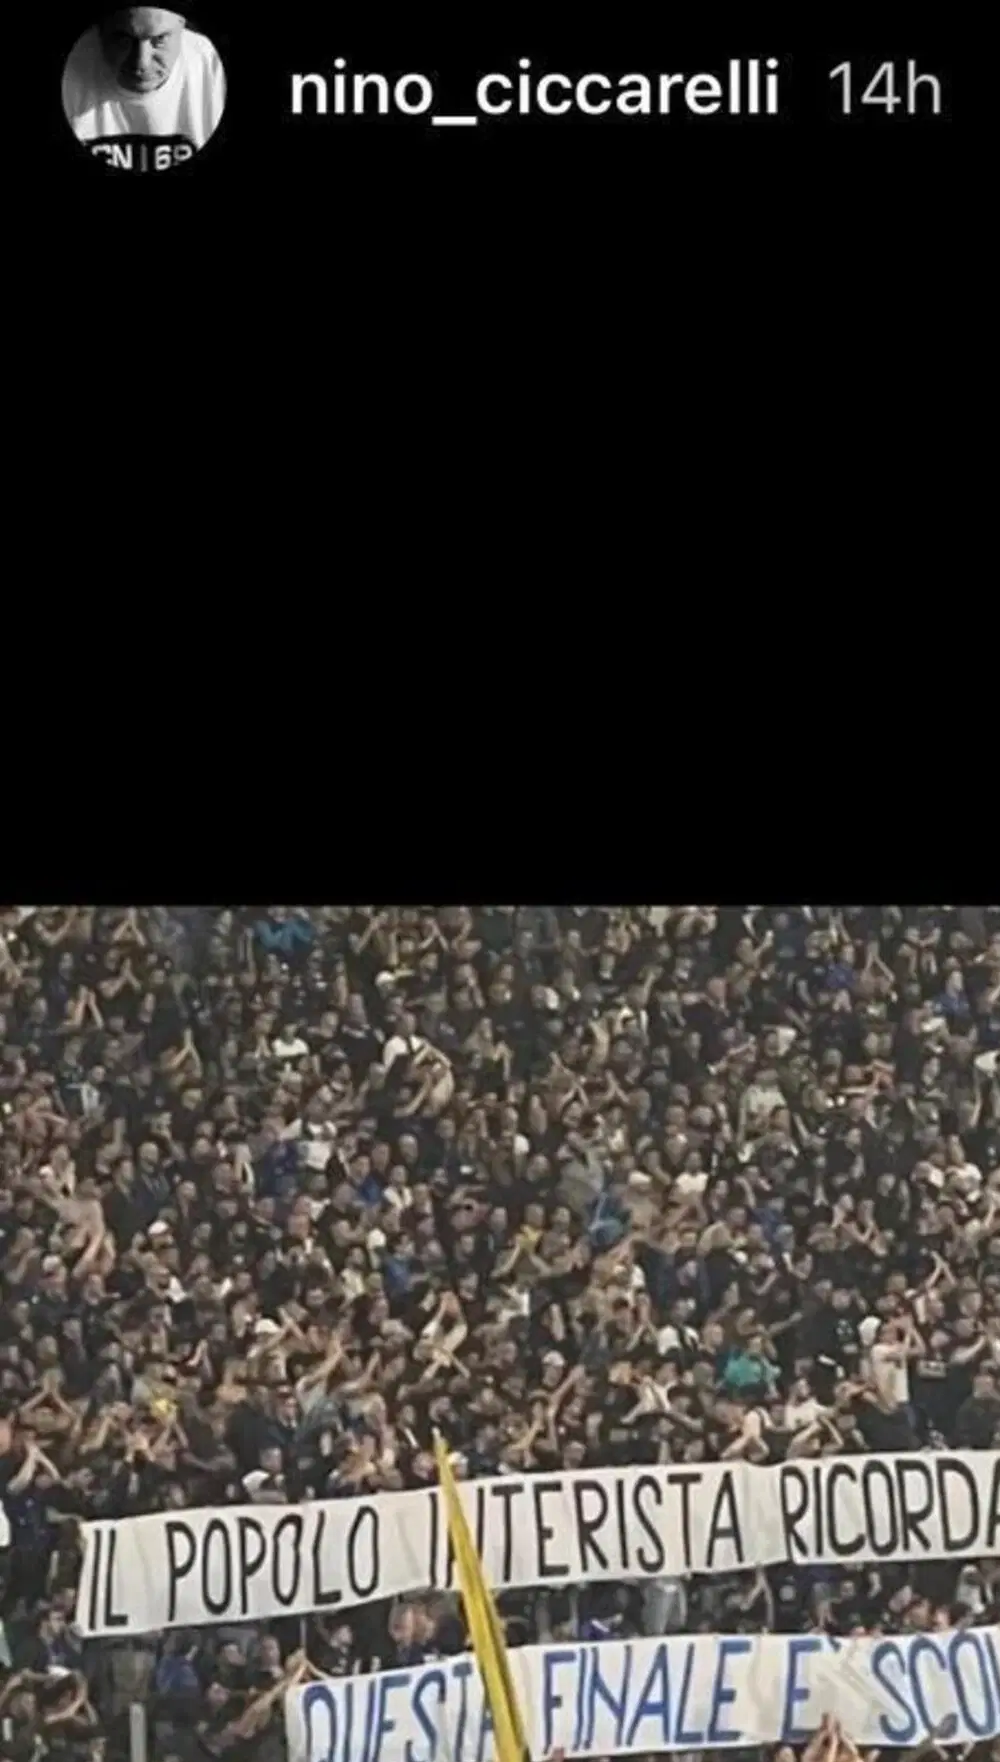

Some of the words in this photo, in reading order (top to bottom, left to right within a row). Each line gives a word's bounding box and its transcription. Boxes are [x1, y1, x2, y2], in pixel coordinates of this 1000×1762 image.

[86, 1526, 129, 1629] IL
[166, 1505, 380, 1622] POPOLO
[543, 1640, 752, 1751] FINALE
